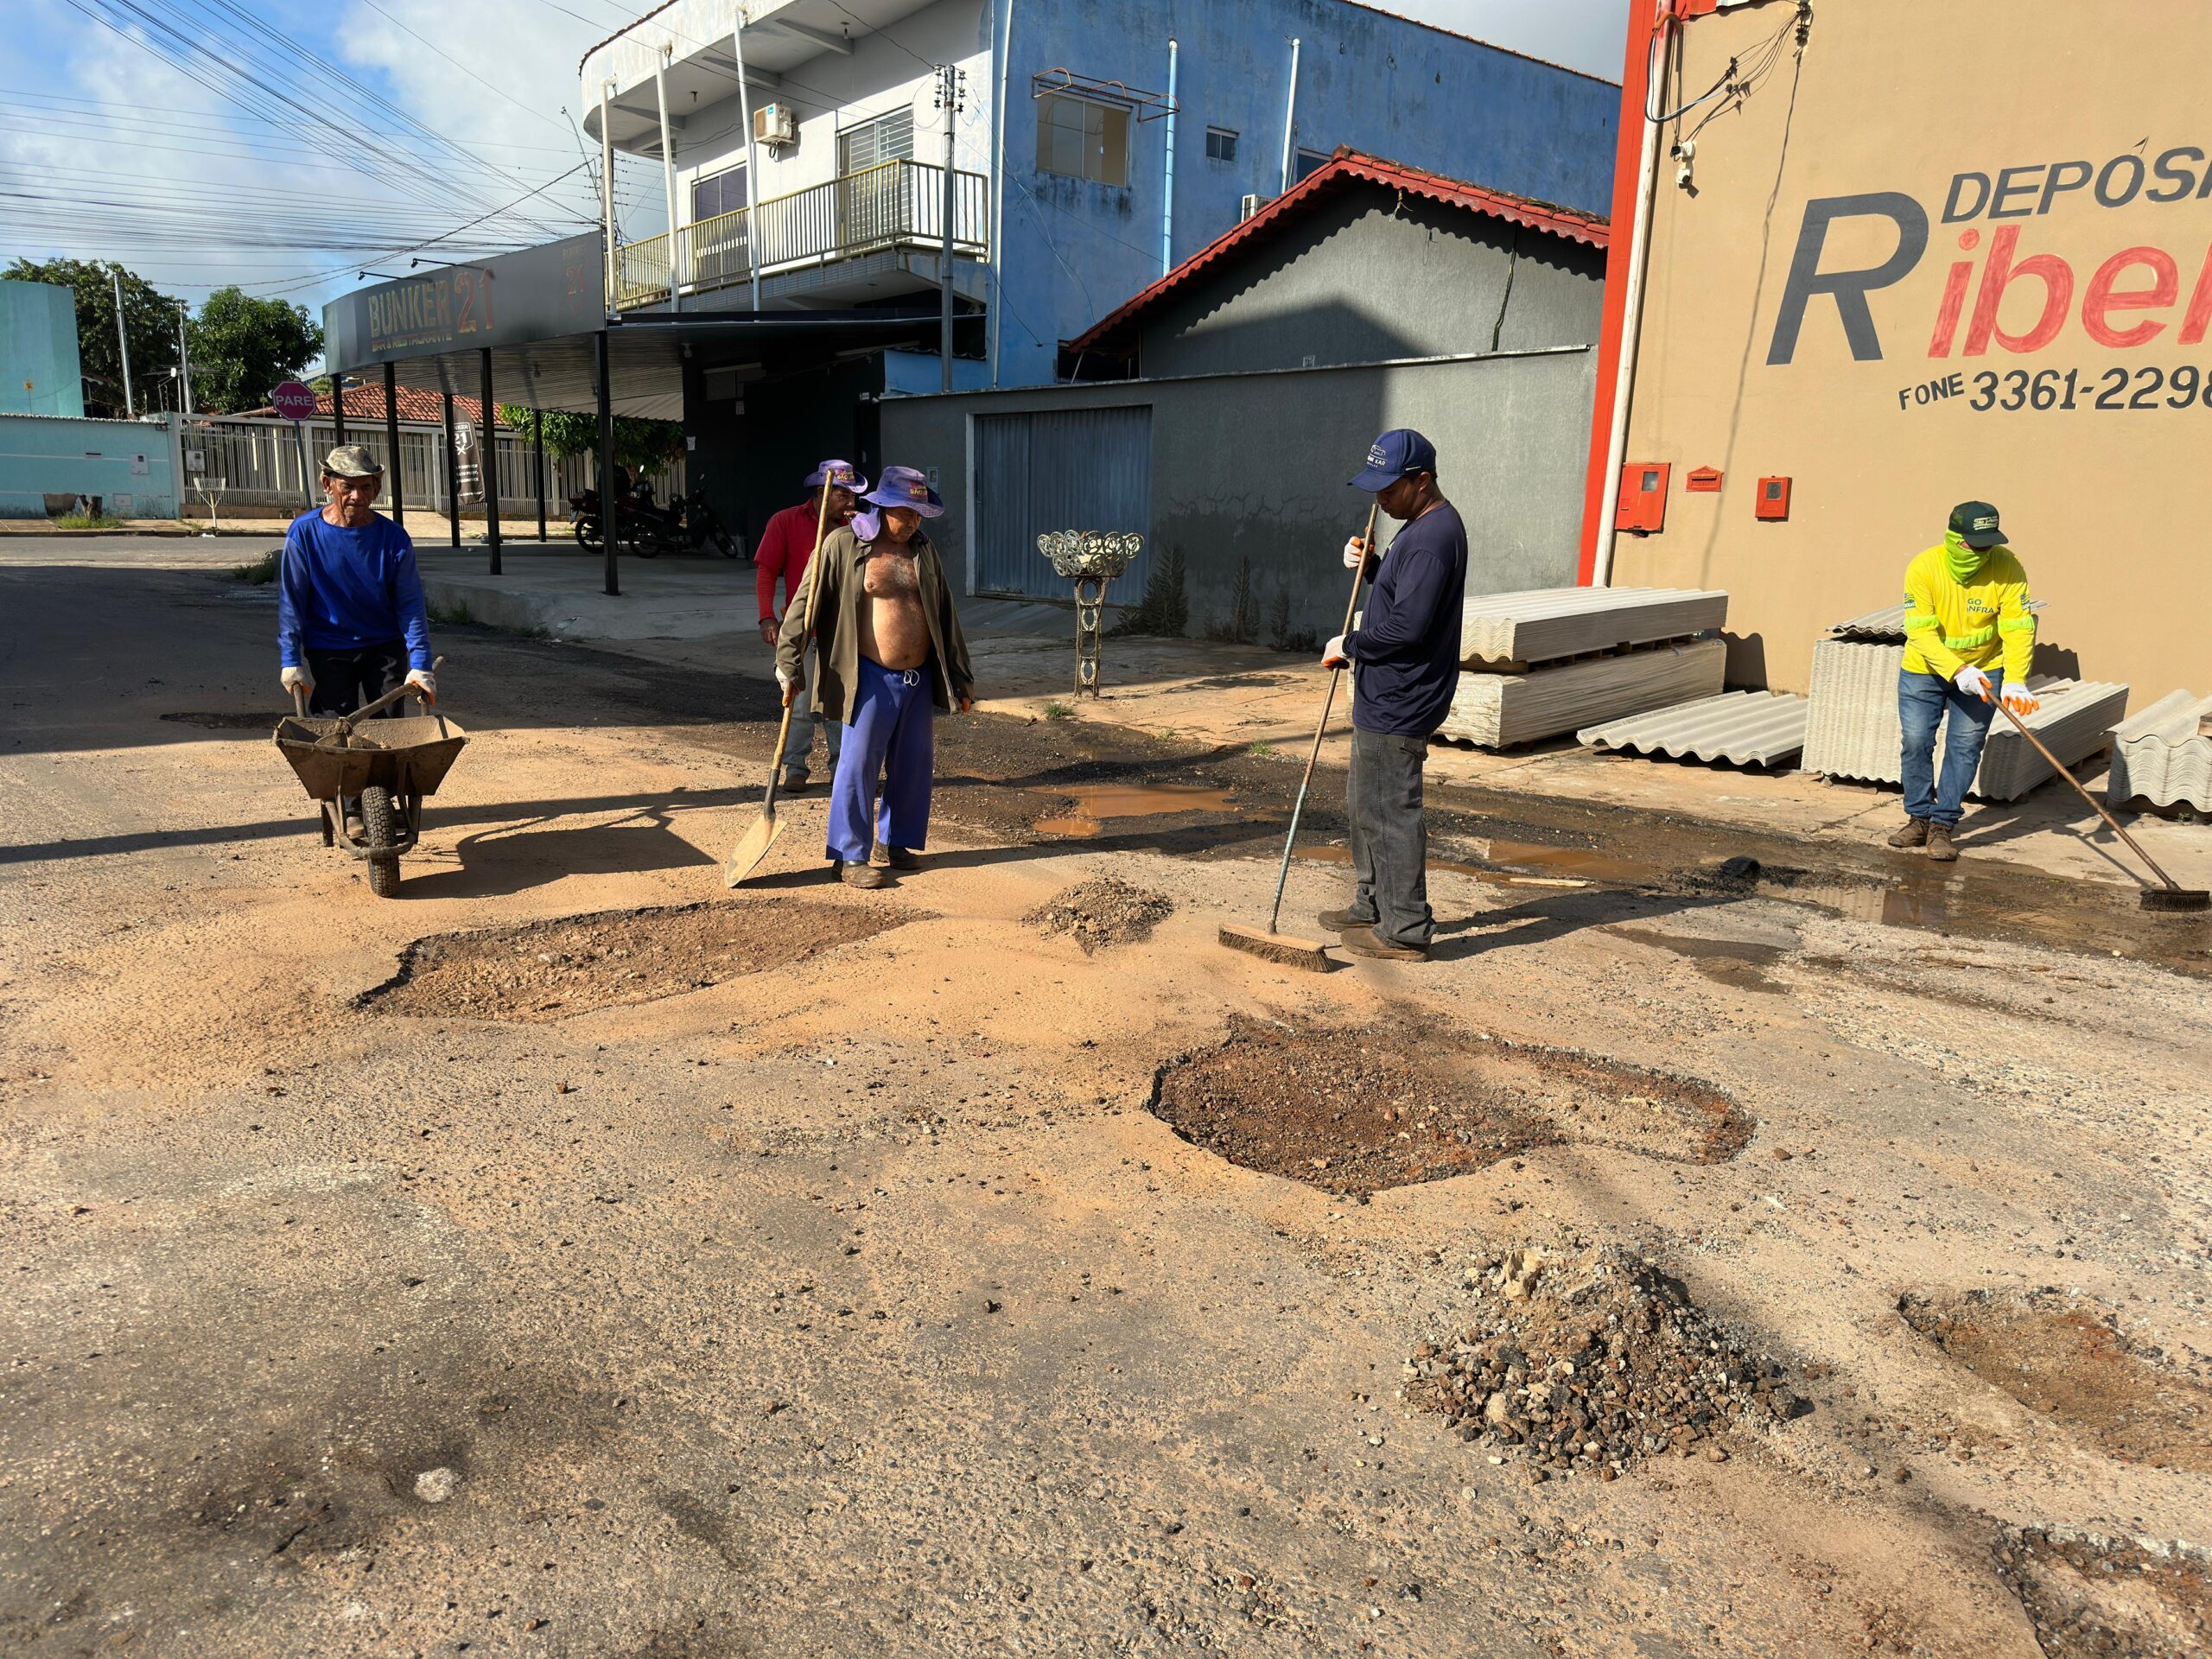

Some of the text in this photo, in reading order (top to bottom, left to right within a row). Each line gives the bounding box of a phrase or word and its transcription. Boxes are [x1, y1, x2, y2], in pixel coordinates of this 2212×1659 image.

[369, 268, 493, 339] BUNKER 21
[276, 395, 313, 406] PARE
[1898, 372, 1965, 410] FONE
